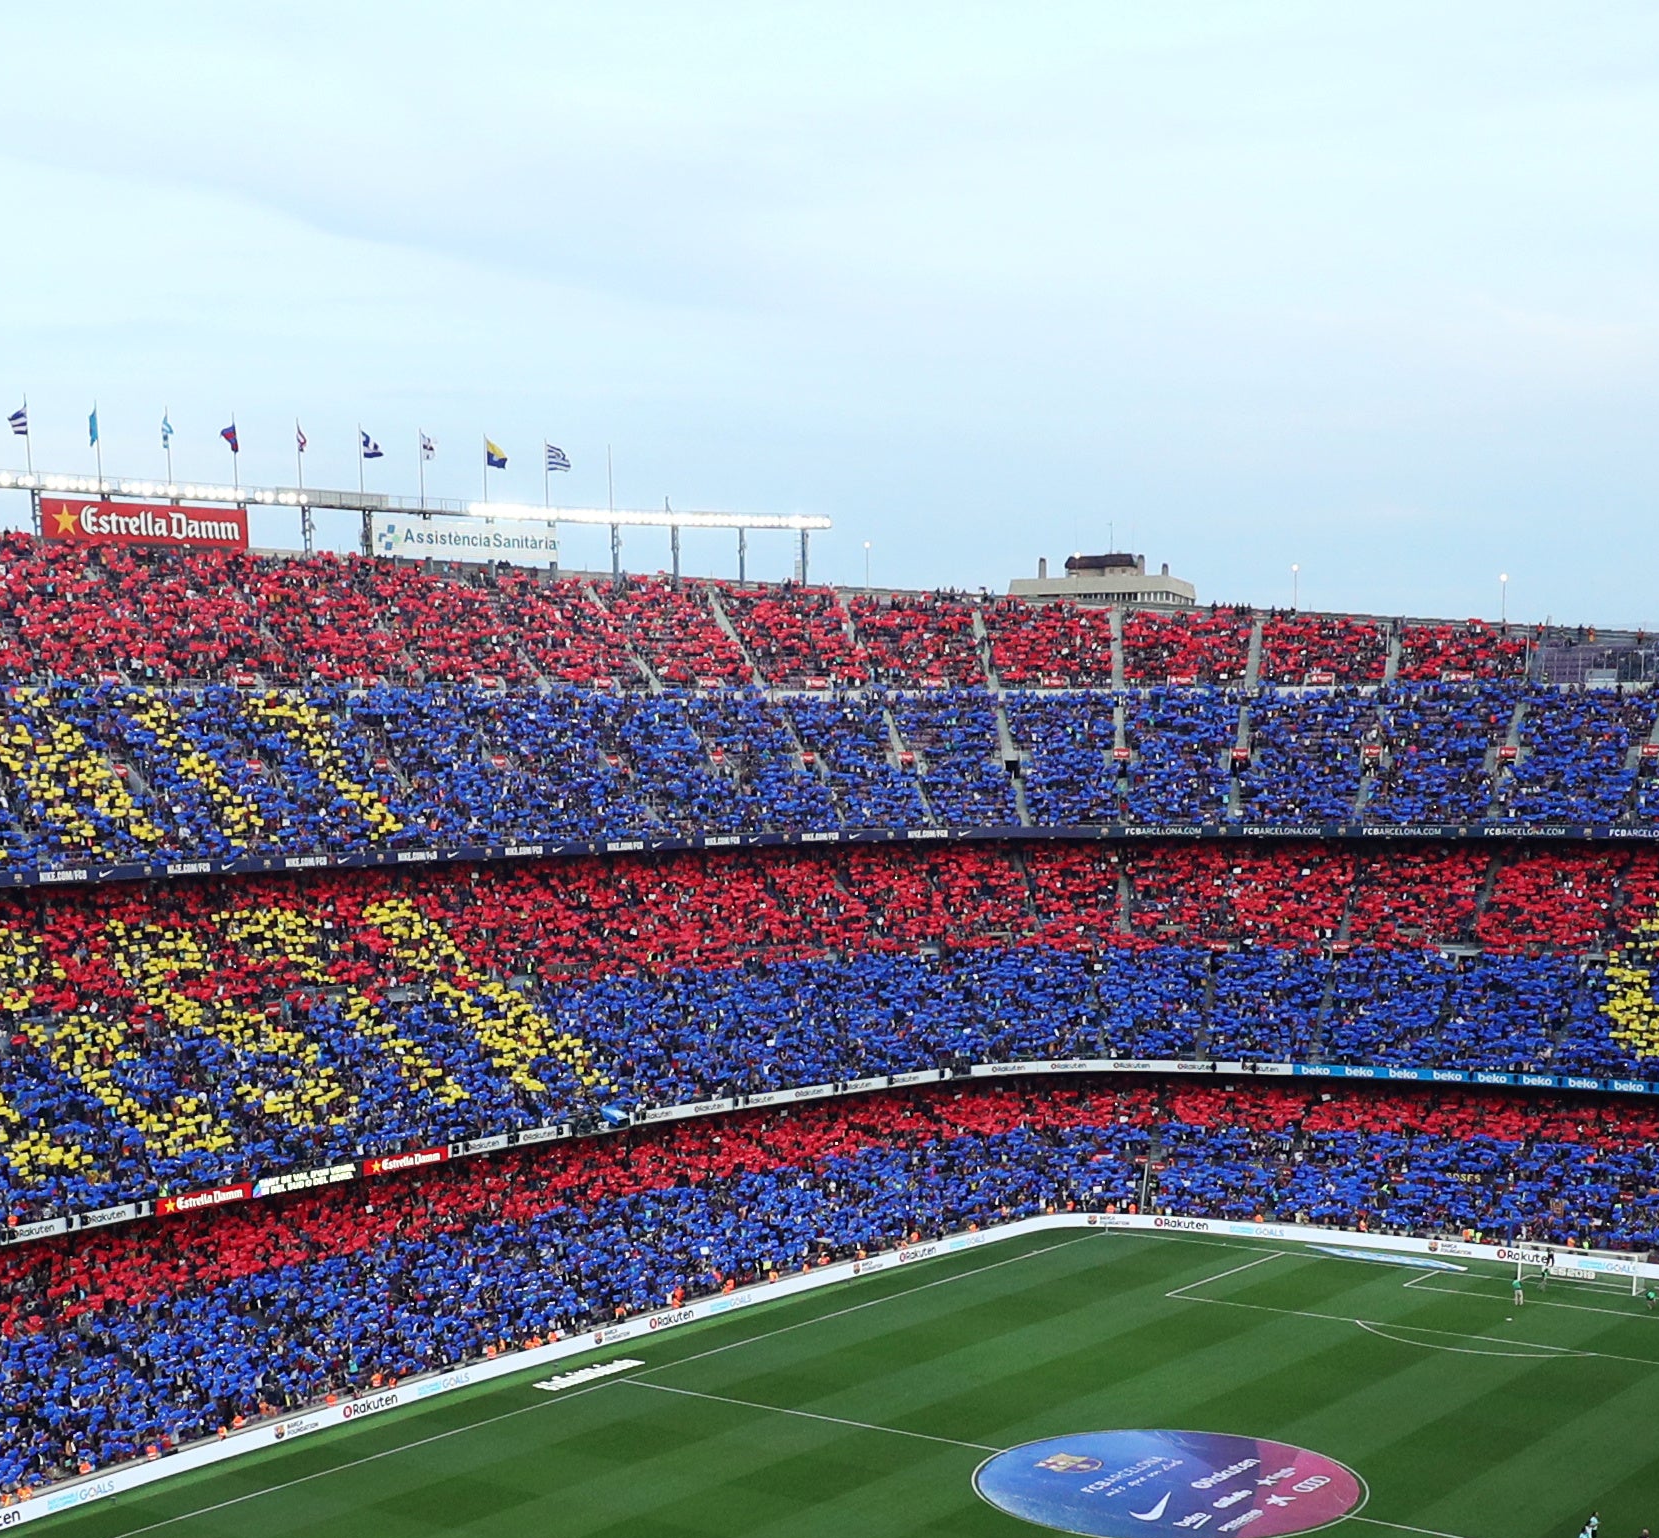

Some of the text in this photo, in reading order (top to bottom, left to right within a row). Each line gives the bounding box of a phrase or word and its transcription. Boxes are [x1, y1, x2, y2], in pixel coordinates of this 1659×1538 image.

[80, 504, 241, 541] Estrella Damm
[404, 528, 557, 551] Assistència Sanitària
[1243, 827, 1321, 836] FCBARCELONA.COM
[1362, 827, 1442, 836] FCBARCELONA.COM
[1301, 1065, 1330, 1075] beko
[1345, 1066, 1374, 1077] beko
[1389, 1068, 1418, 1079] beko
[1433, 1070, 1463, 1081] beko
[1477, 1072, 1507, 1084] beko
[1523, 1074, 1553, 1086] beko
[1568, 1078, 1598, 1089] beko
[1614, 1080, 1644, 1092] beko
[382, 1153, 441, 1171] Estrella Damm
[176, 1188, 243, 1211] Estrella Damm
[1164, 1218, 1209, 1231] Rakuten
[1255, 1226, 1284, 1237] GOALS
[905, 1245, 937, 1261] Rakuten
[657, 1309, 695, 1328] Rakuten
[442, 1372, 471, 1390] GOALS
[352, 1393, 399, 1416] Rakuten
[79, 1480, 115, 1502] GOALS
